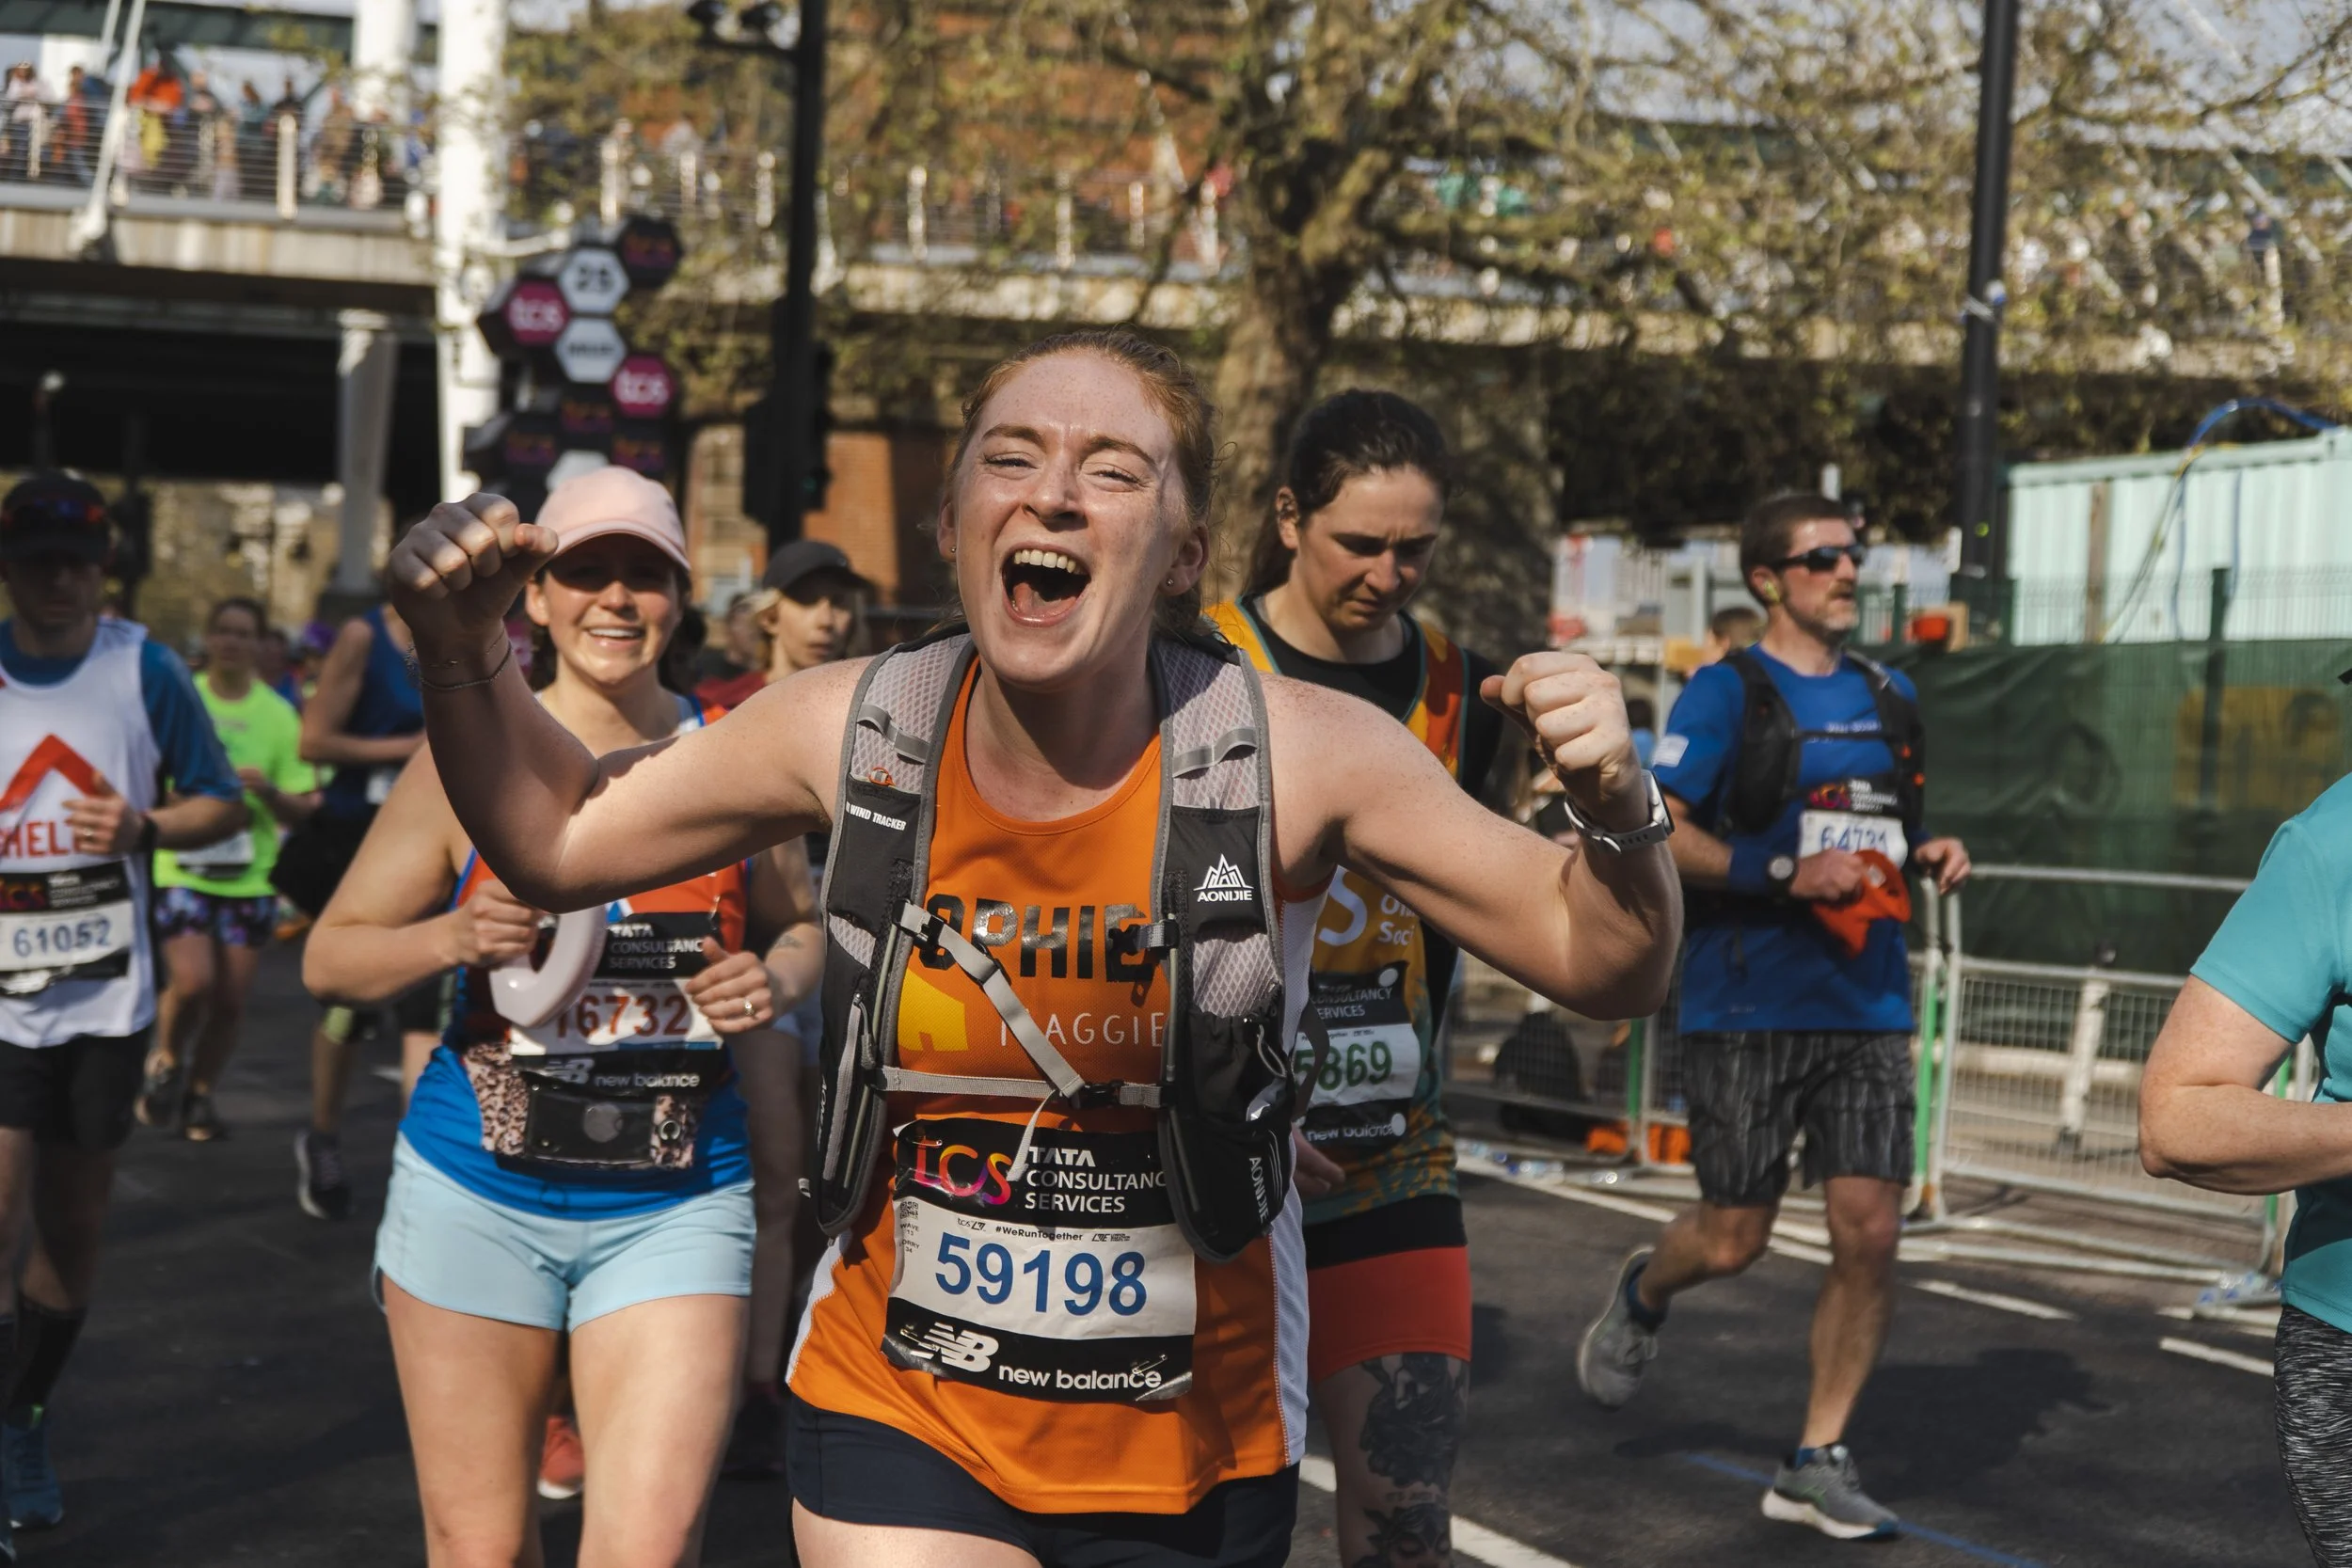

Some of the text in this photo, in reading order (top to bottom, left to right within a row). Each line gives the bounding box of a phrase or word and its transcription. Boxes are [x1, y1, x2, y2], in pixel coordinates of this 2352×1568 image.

[850, 804, 872, 820] WIND
[872, 812, 907, 832] TRACKER
[1197, 890, 1253, 902] AONIJIE
[13, 918, 112, 958] 61052
[611, 924, 654, 938] TATA
[919, 893, 1153, 983] OPHIE
[611, 938, 704, 955] CONSULTANC
[610, 957, 676, 970] SERVICES
[1317, 1005, 1366, 1020] ERVICES
[596, 1073, 700, 1087] new balance
[1027, 1146, 1096, 1167] TATA
[914, 1132, 1012, 1204] tcs
[1026, 1169, 1167, 1190] CONSULTANC
[1248, 1156, 1269, 1224] AONIJIE
[1025, 1193, 1126, 1213] SERVICES
[899, 1223, 919, 1232] WAVE
[995, 1226, 1084, 1242] #WeRunTogether
[935, 1231, 1148, 1317] 59198
[998, 1364, 1162, 1391] new balance
